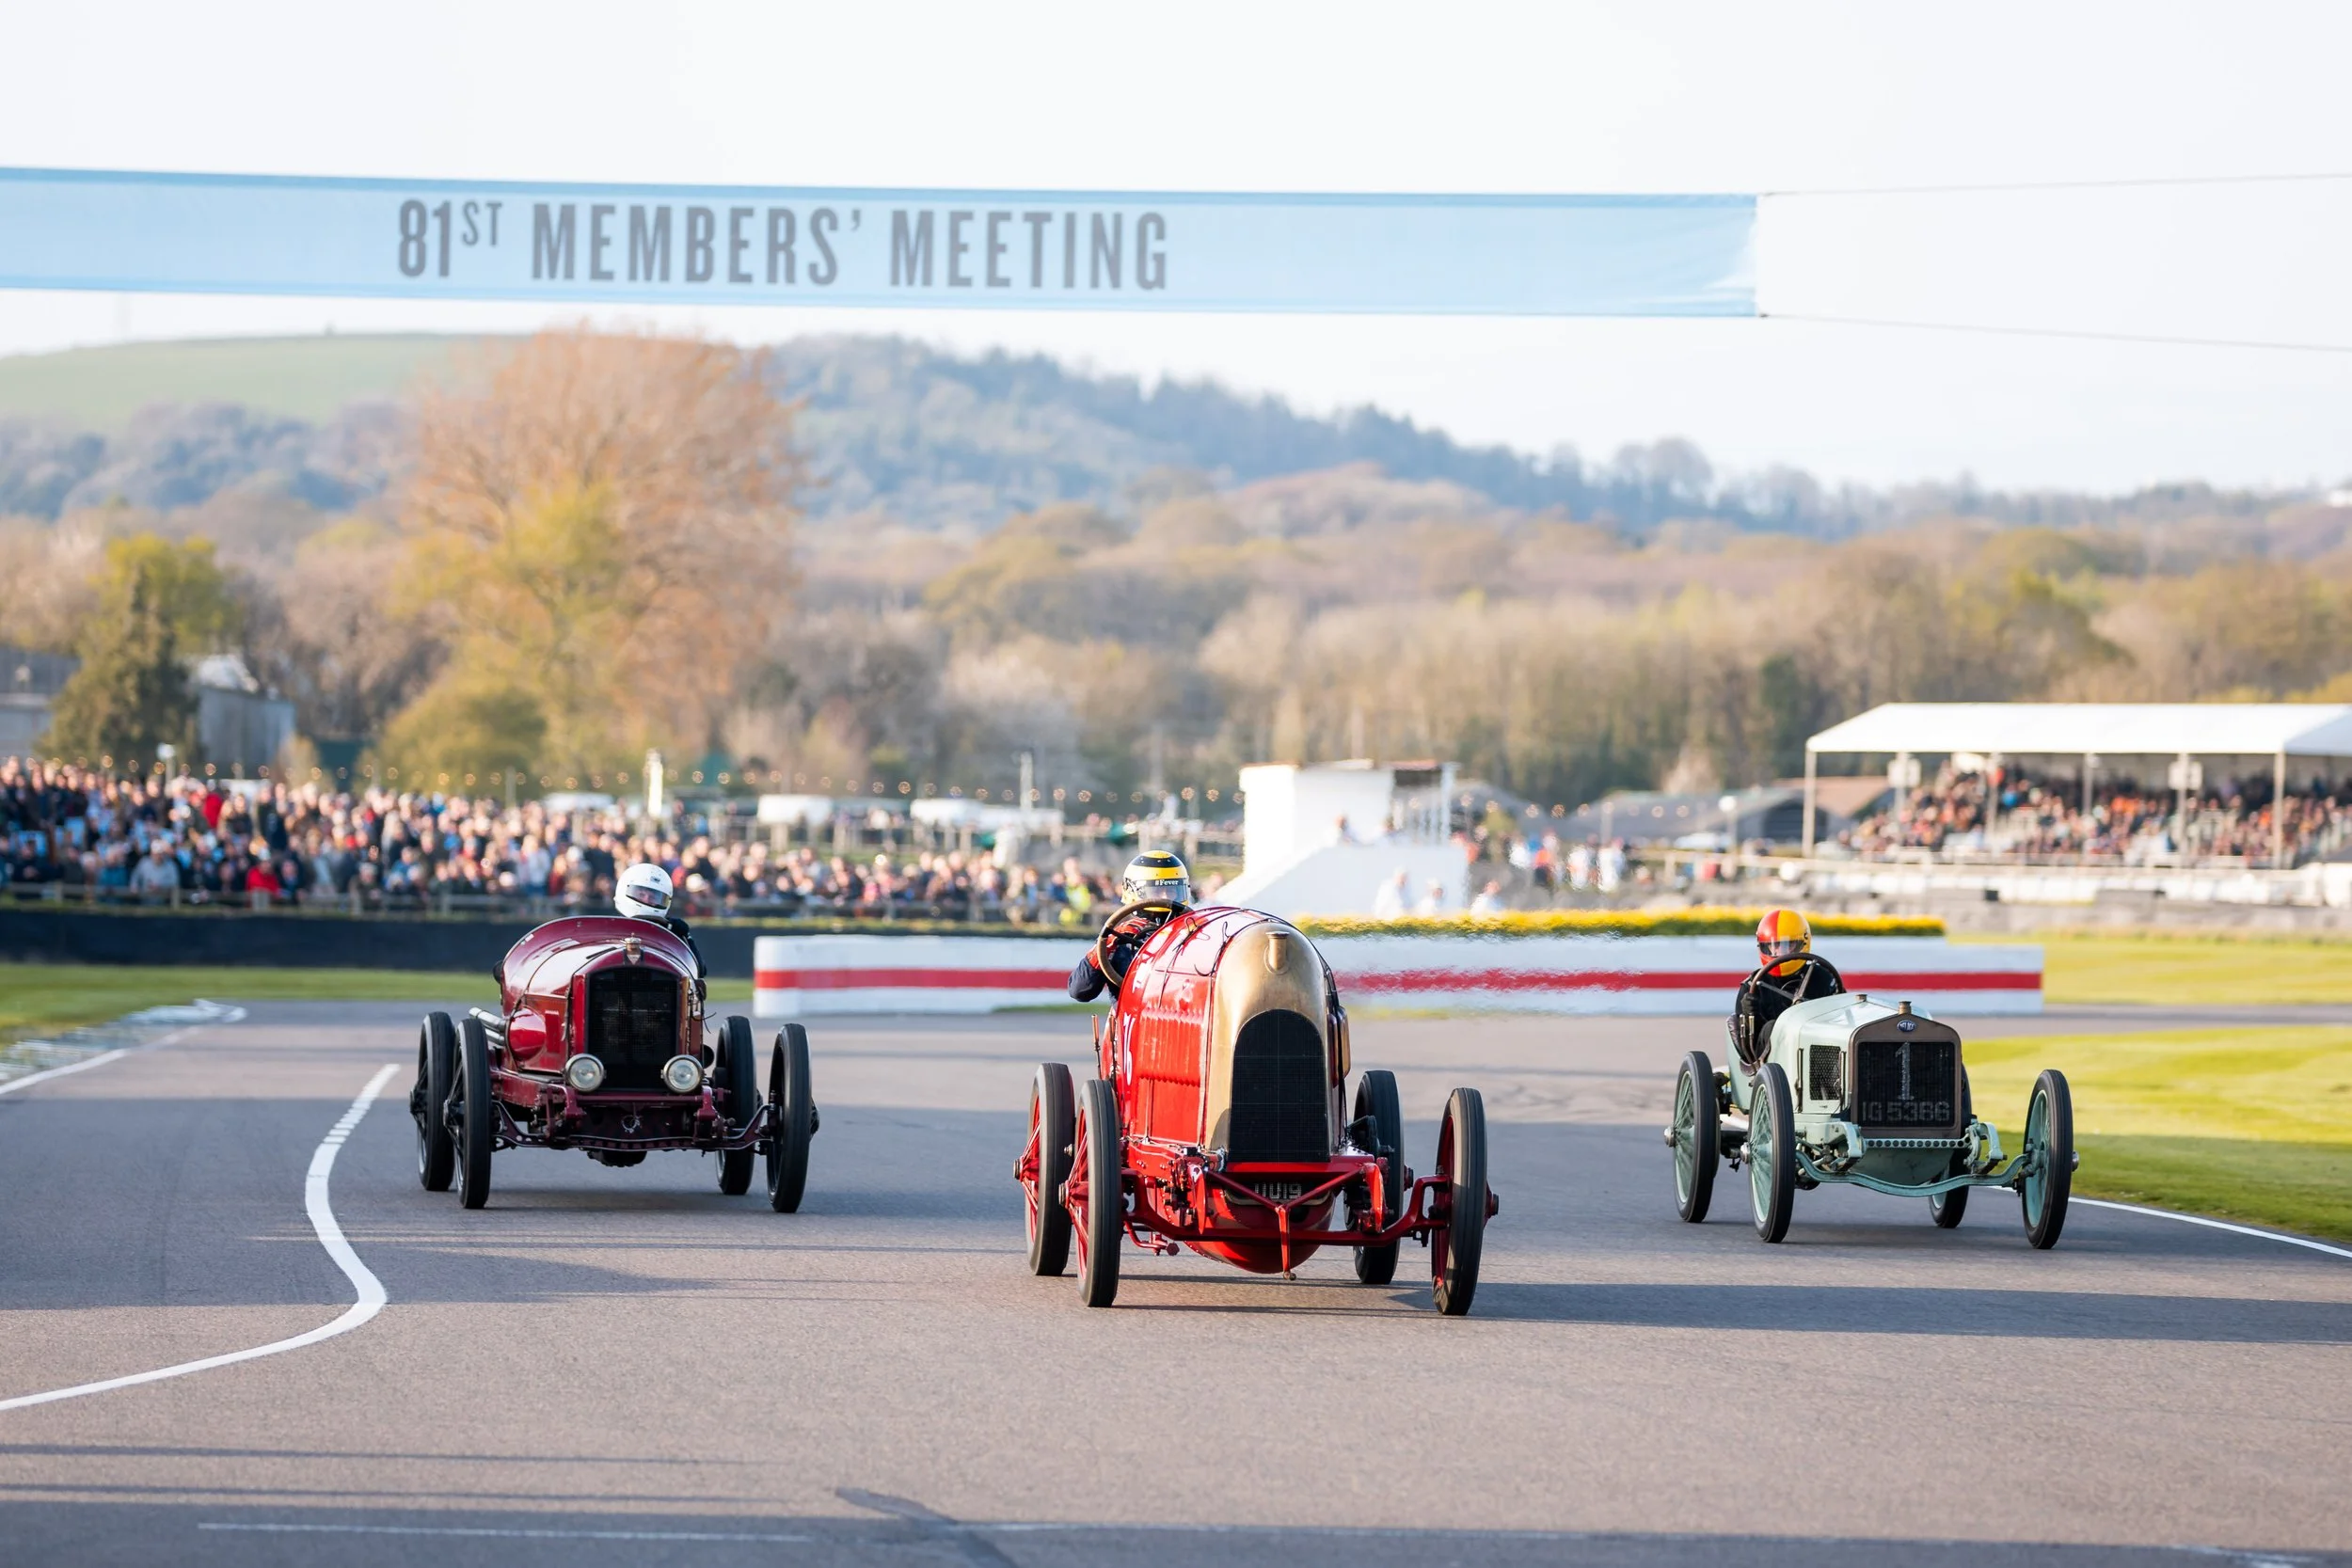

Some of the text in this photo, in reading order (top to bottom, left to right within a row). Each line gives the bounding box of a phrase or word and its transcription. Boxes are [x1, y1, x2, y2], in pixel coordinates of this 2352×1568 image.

[398, 198, 502, 277] 81ST
[890, 209, 1166, 291] MEETING
[1895, 1040, 1915, 1101] 1
